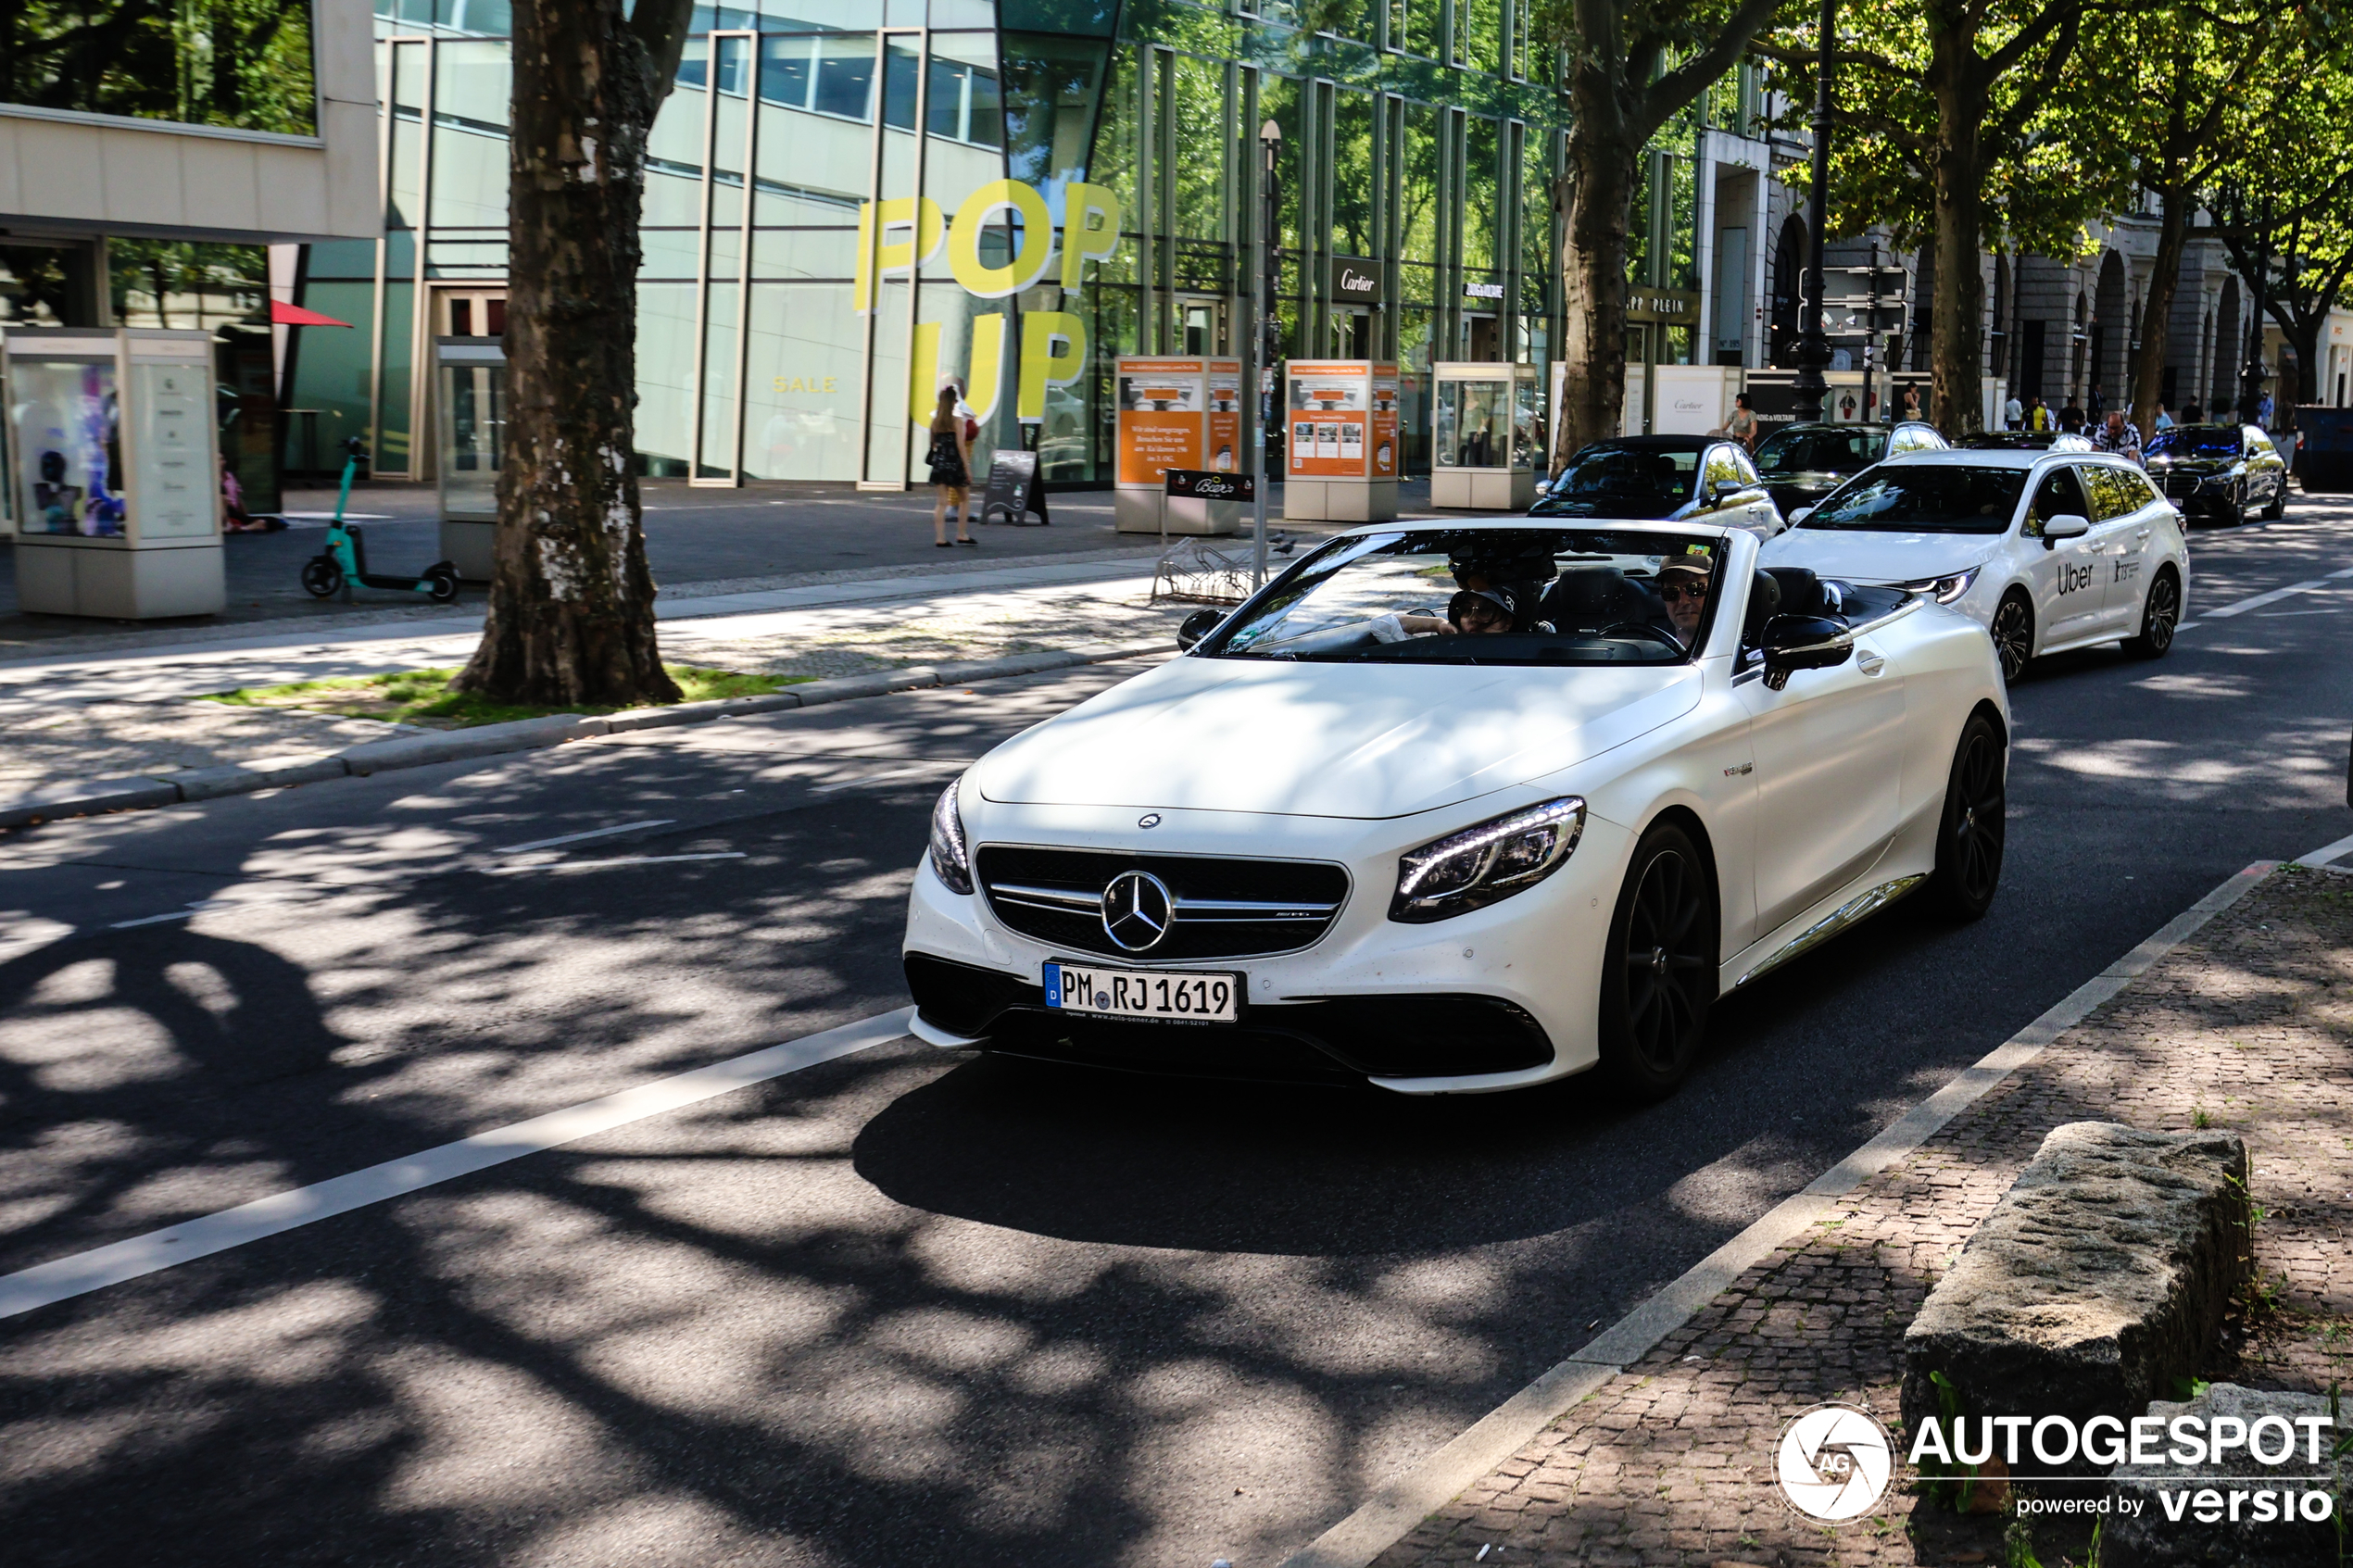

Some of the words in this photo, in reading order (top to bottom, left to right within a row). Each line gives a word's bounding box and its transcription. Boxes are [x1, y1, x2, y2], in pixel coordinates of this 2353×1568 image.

[853, 179, 1121, 316] POP
[1340, 268, 1376, 292] Cartier
[1653, 298, 1683, 313] PLEIN
[910, 311, 1088, 433] UP
[772, 375, 838, 394] SALE
[1674, 398, 1705, 409] Cartier
[2057, 562, 2094, 596] Uber
[1050, 989, 1057, 1000] D
[1062, 971, 1093, 1007] PM
[1114, 976, 1148, 1010] RJ
[1156, 978, 1229, 1014] 1619
